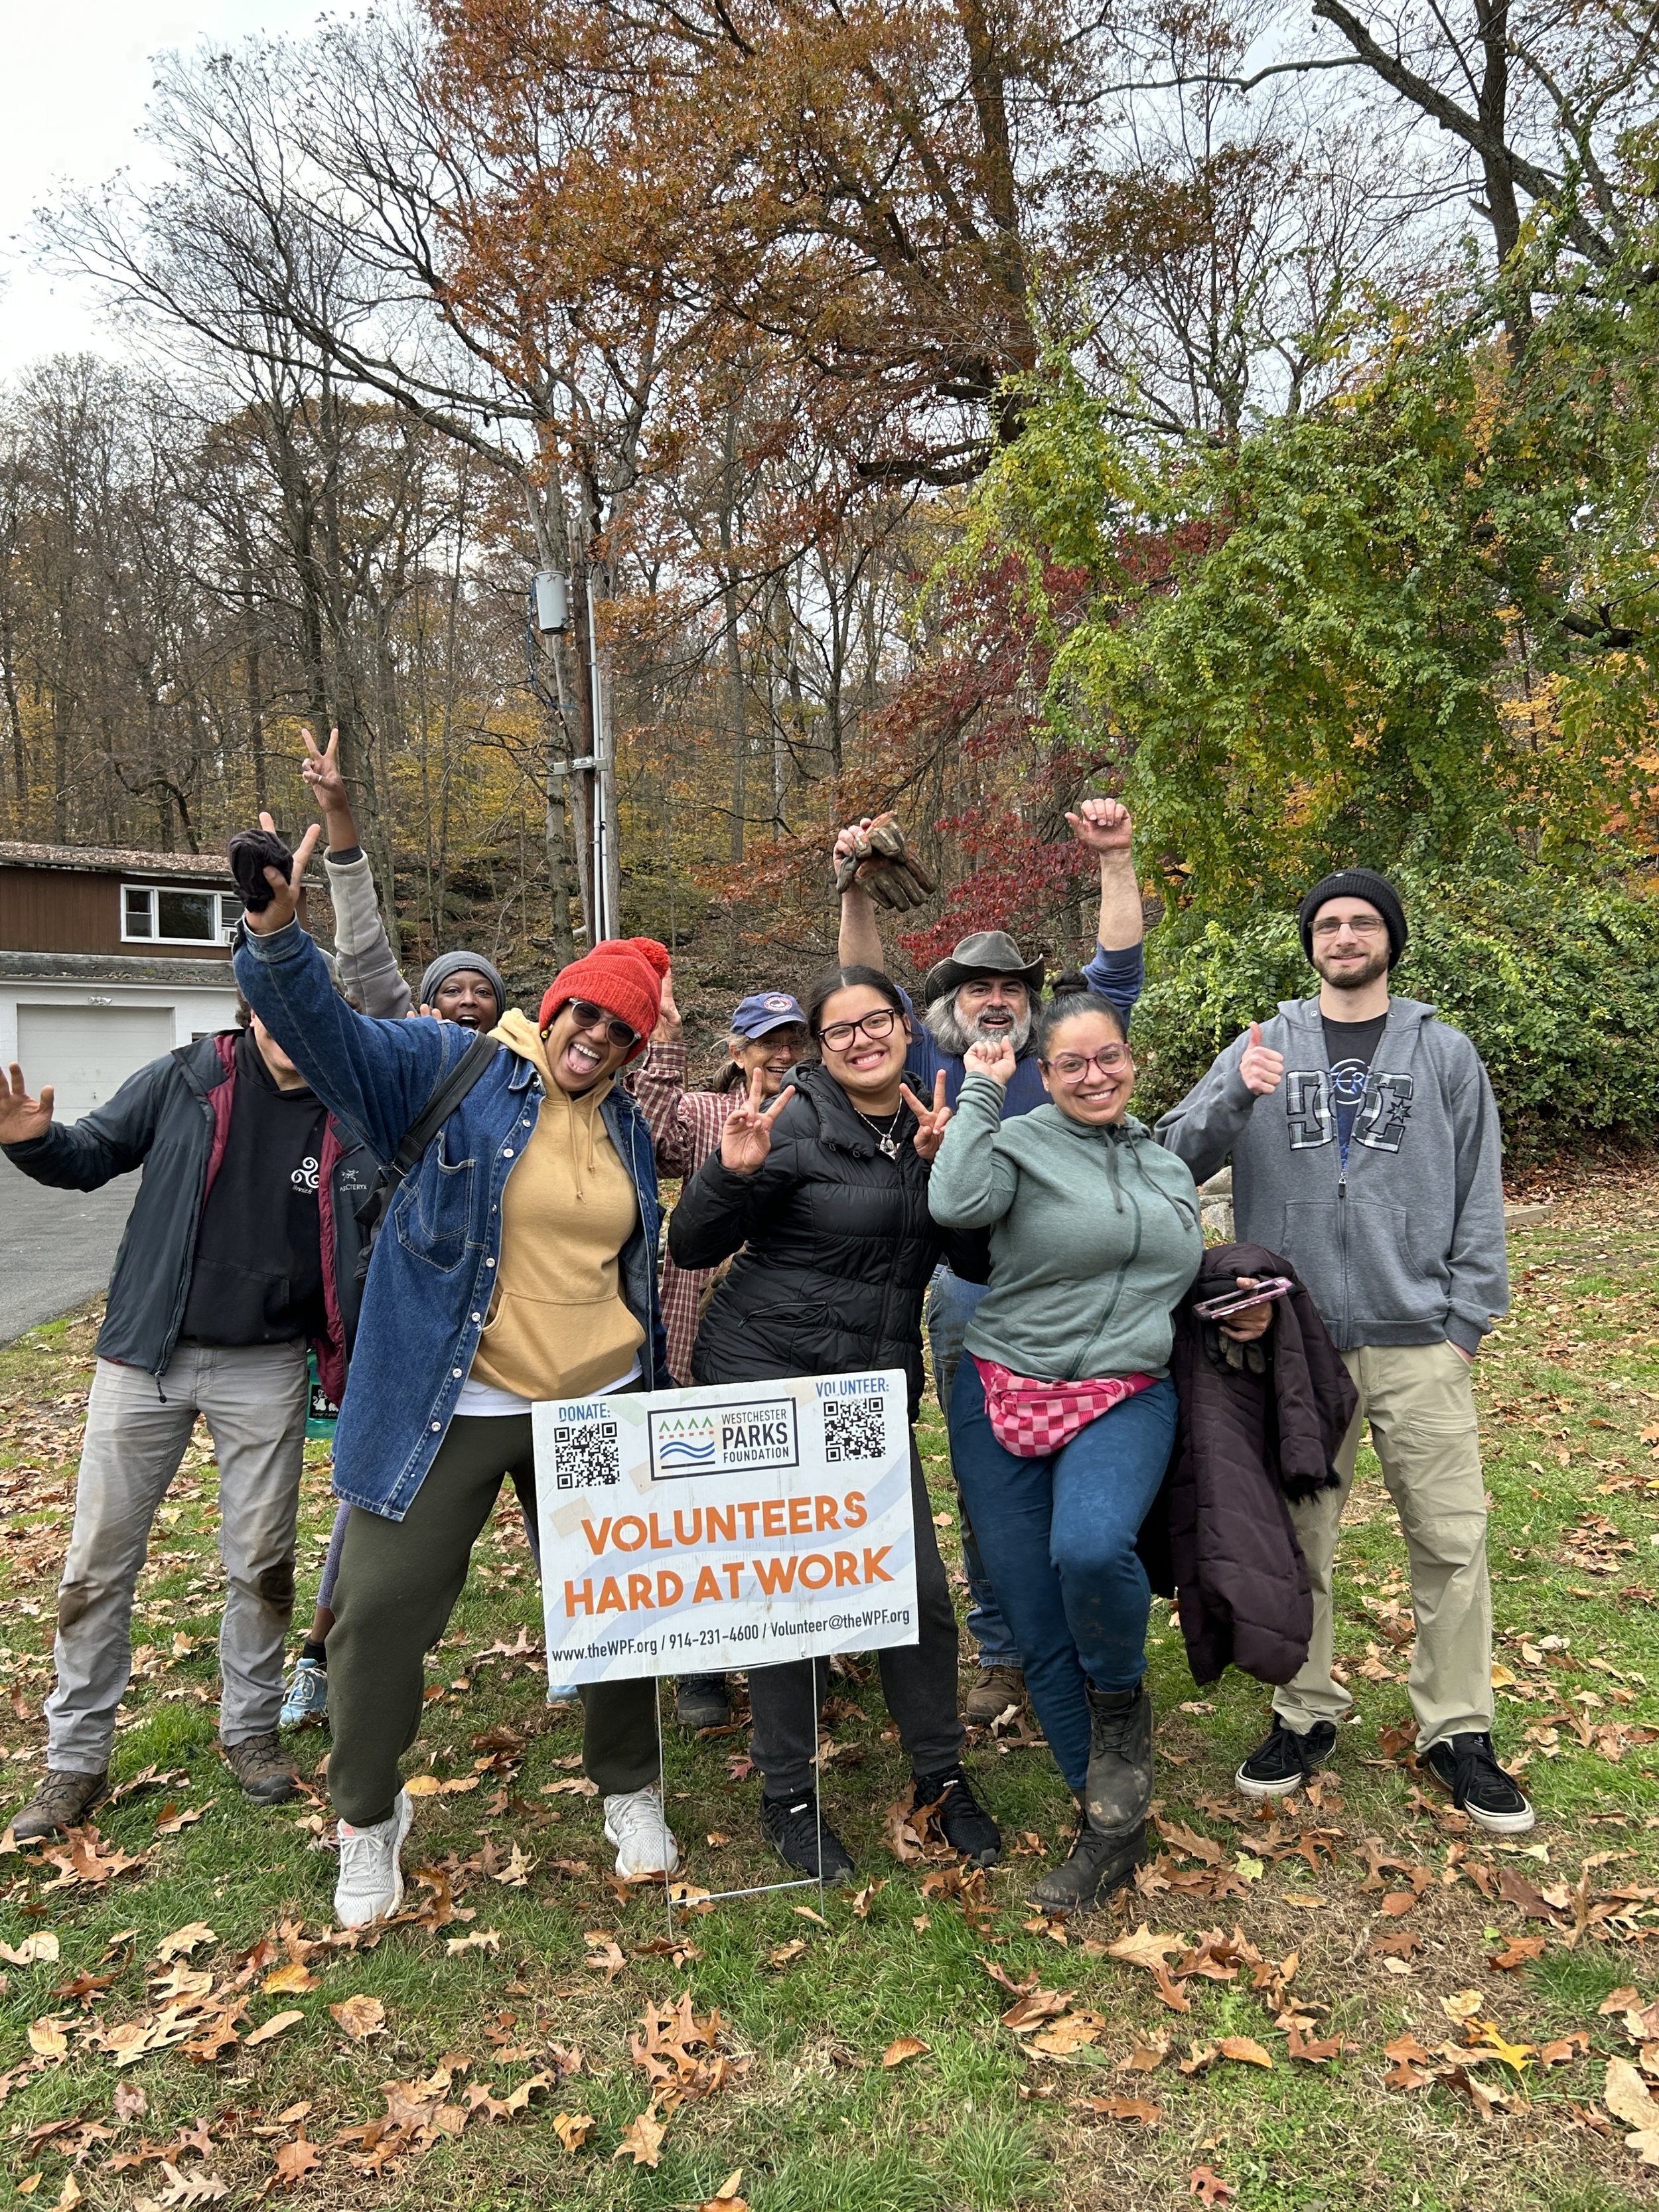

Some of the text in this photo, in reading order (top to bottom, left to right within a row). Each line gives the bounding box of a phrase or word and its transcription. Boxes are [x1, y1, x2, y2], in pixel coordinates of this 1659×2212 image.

[816, 1378, 889, 1398] VOLUNTEER:
[559, 1403, 611, 1422] DONATE:
[721, 1409, 787, 1424] WESTCHESTER
[722, 1422, 788, 1449] PARKS
[723, 1446, 790, 1463] FOUNDATION
[581, 1491, 868, 1556] VOLUNTEERS
[564, 1545, 896, 1617] HARD AT WORK
[552, 1607, 910, 1662] www.theWPF.org / 914-231-4600 / Volunteer@theWPF.org
